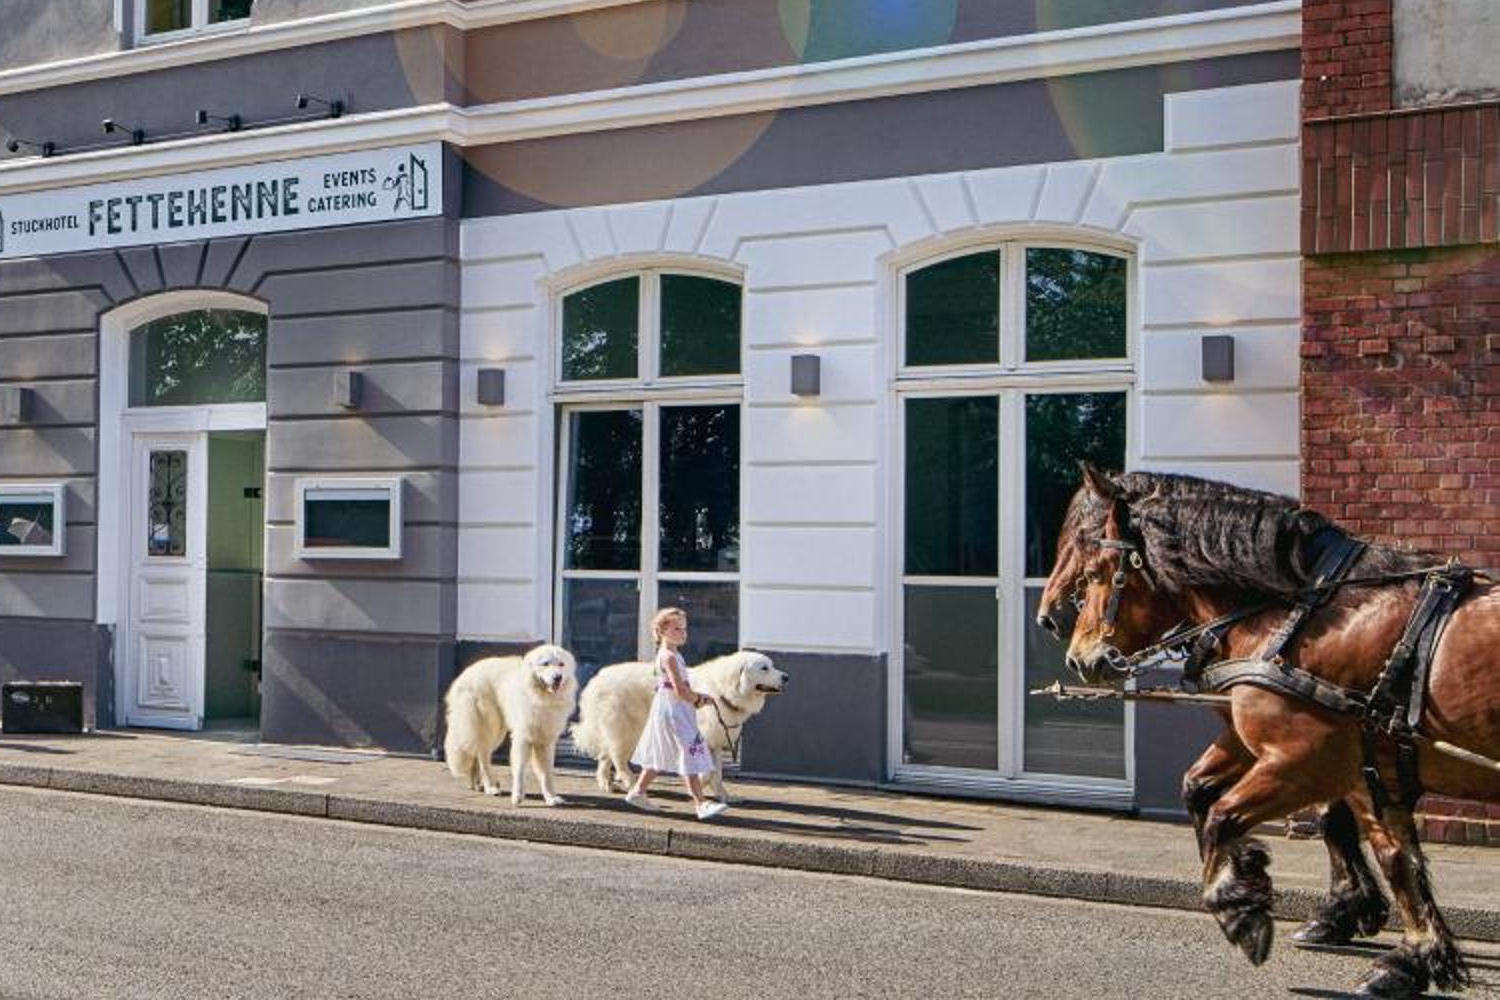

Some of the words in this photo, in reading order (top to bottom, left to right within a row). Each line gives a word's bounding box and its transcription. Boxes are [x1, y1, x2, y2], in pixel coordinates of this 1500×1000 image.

[323, 167, 377, 189] EVENTS
[11, 215, 79, 235] STUCKHOTEL
[88, 177, 300, 236] FETTEHENNE
[307, 191, 377, 213] CATERING
